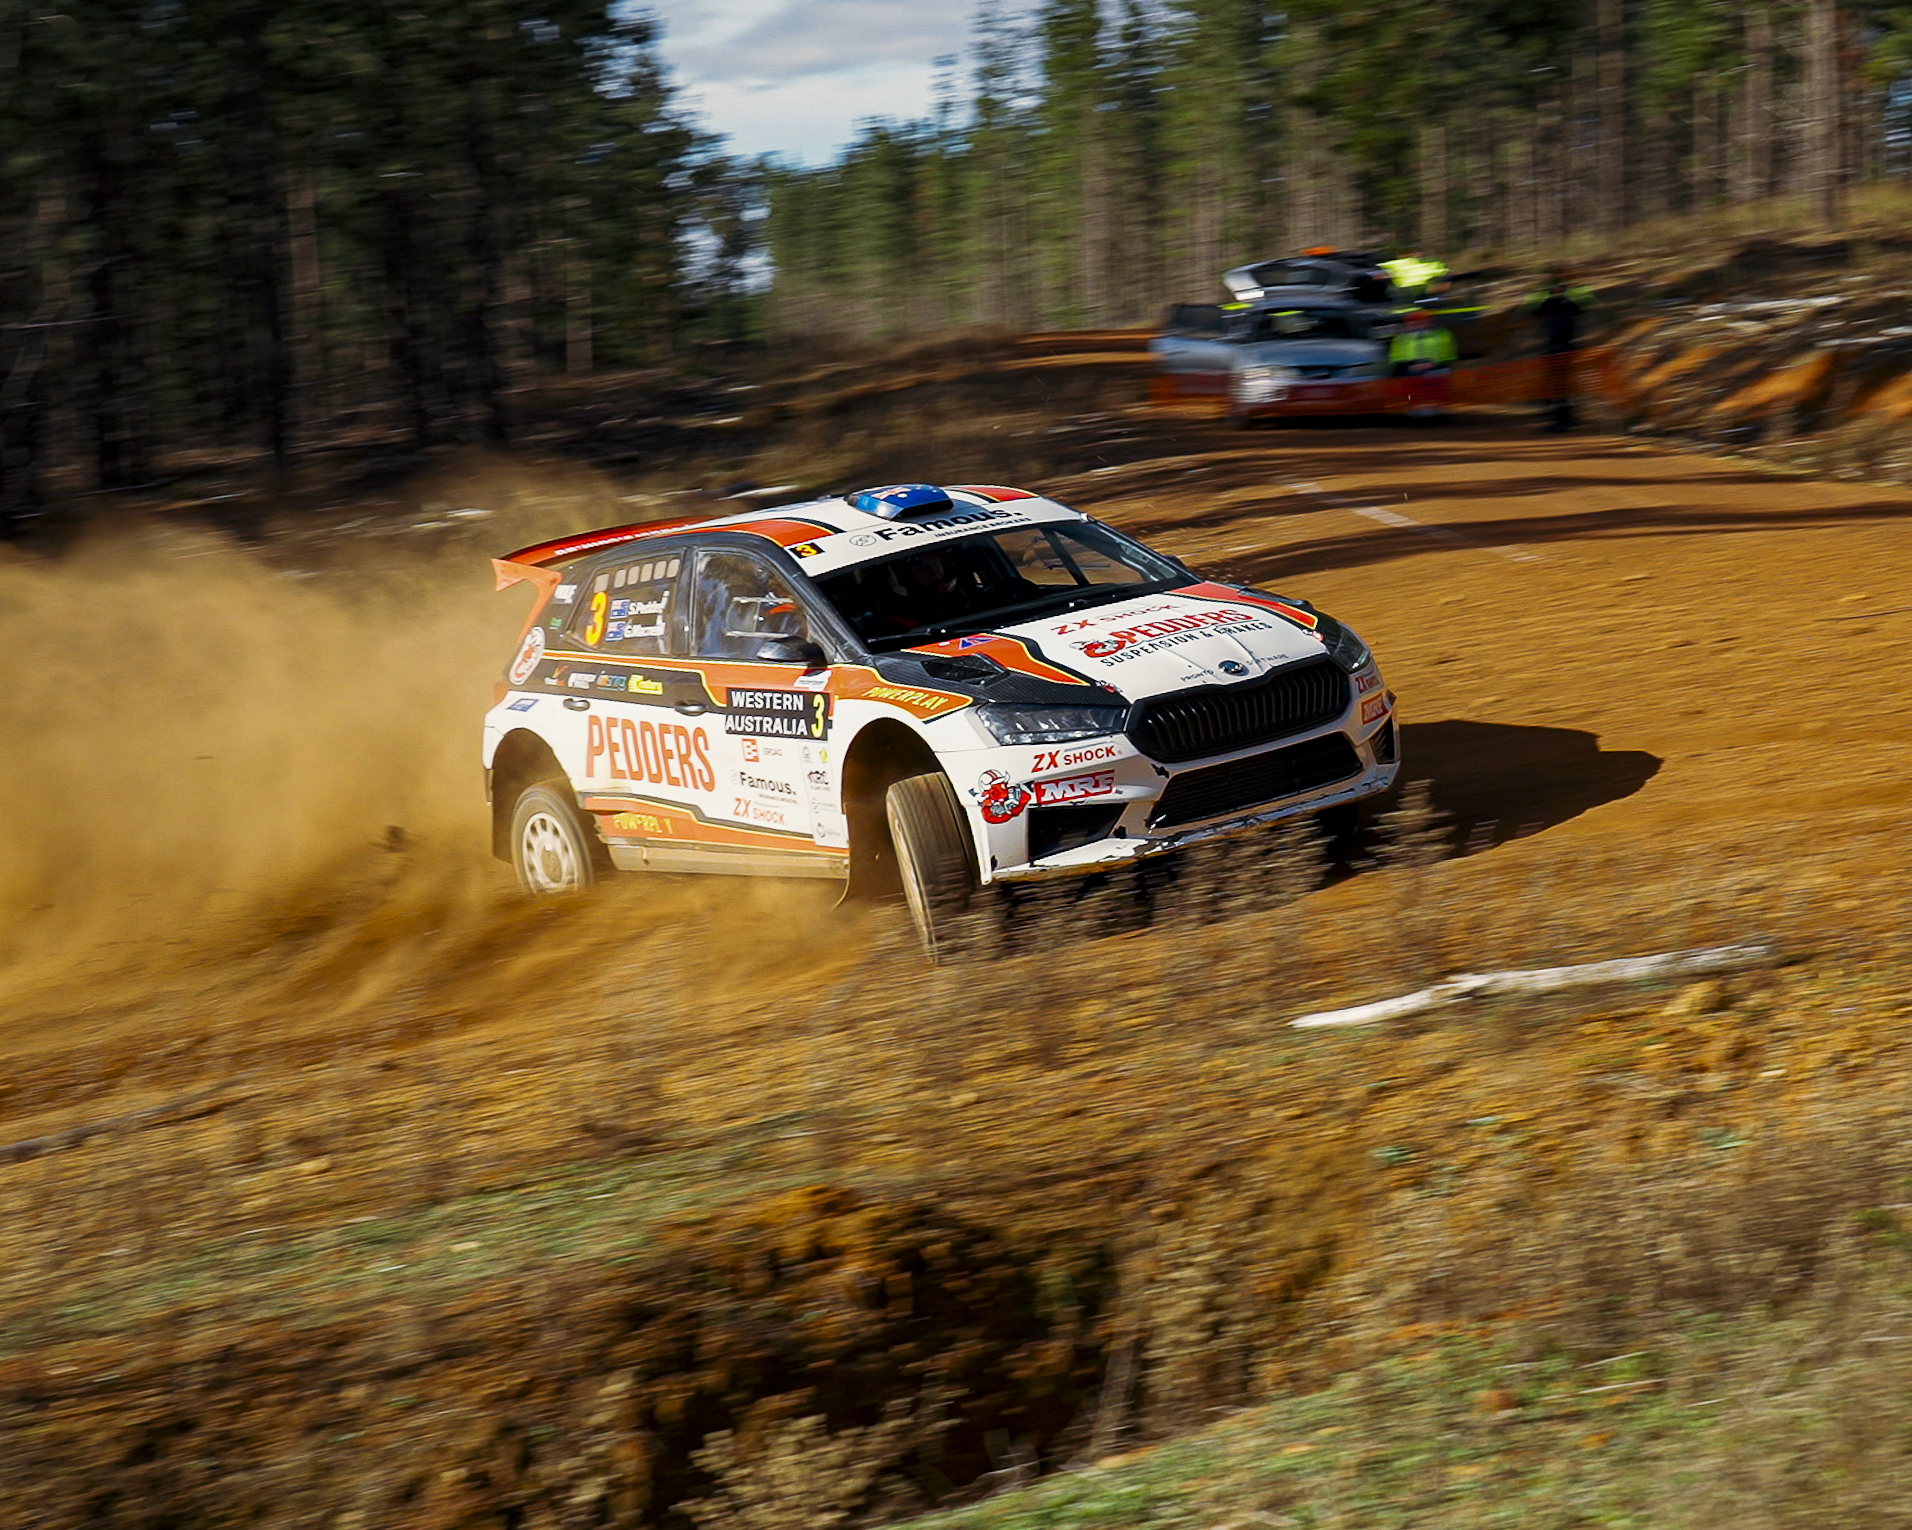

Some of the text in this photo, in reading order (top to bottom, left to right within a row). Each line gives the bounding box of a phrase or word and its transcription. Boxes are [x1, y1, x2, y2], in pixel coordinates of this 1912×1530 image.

[873, 507, 1023, 541] Famous.
[796, 544, 817, 557] 3
[585, 591, 608, 646] 3
[1050, 604, 1176, 636] ZX SHOCK
[1108, 609, 1254, 644] PEDDERS
[1100, 621, 1273, 667] SUSPENSION & BRAKES
[731, 690, 804, 711] WESTERN
[861, 686, 949, 711] POWERPLAY
[725, 714, 808, 736] AUSTRALIA
[811, 693, 825, 738] 3
[586, 714, 715, 792] PEDDERS
[1031, 745, 1116, 773] ZX SHOCK
[740, 771, 797, 796] Famous.
[1041, 773, 1116, 802] MRF
[733, 797, 751, 818] ZX
[753, 807, 786, 825] SHOCK
